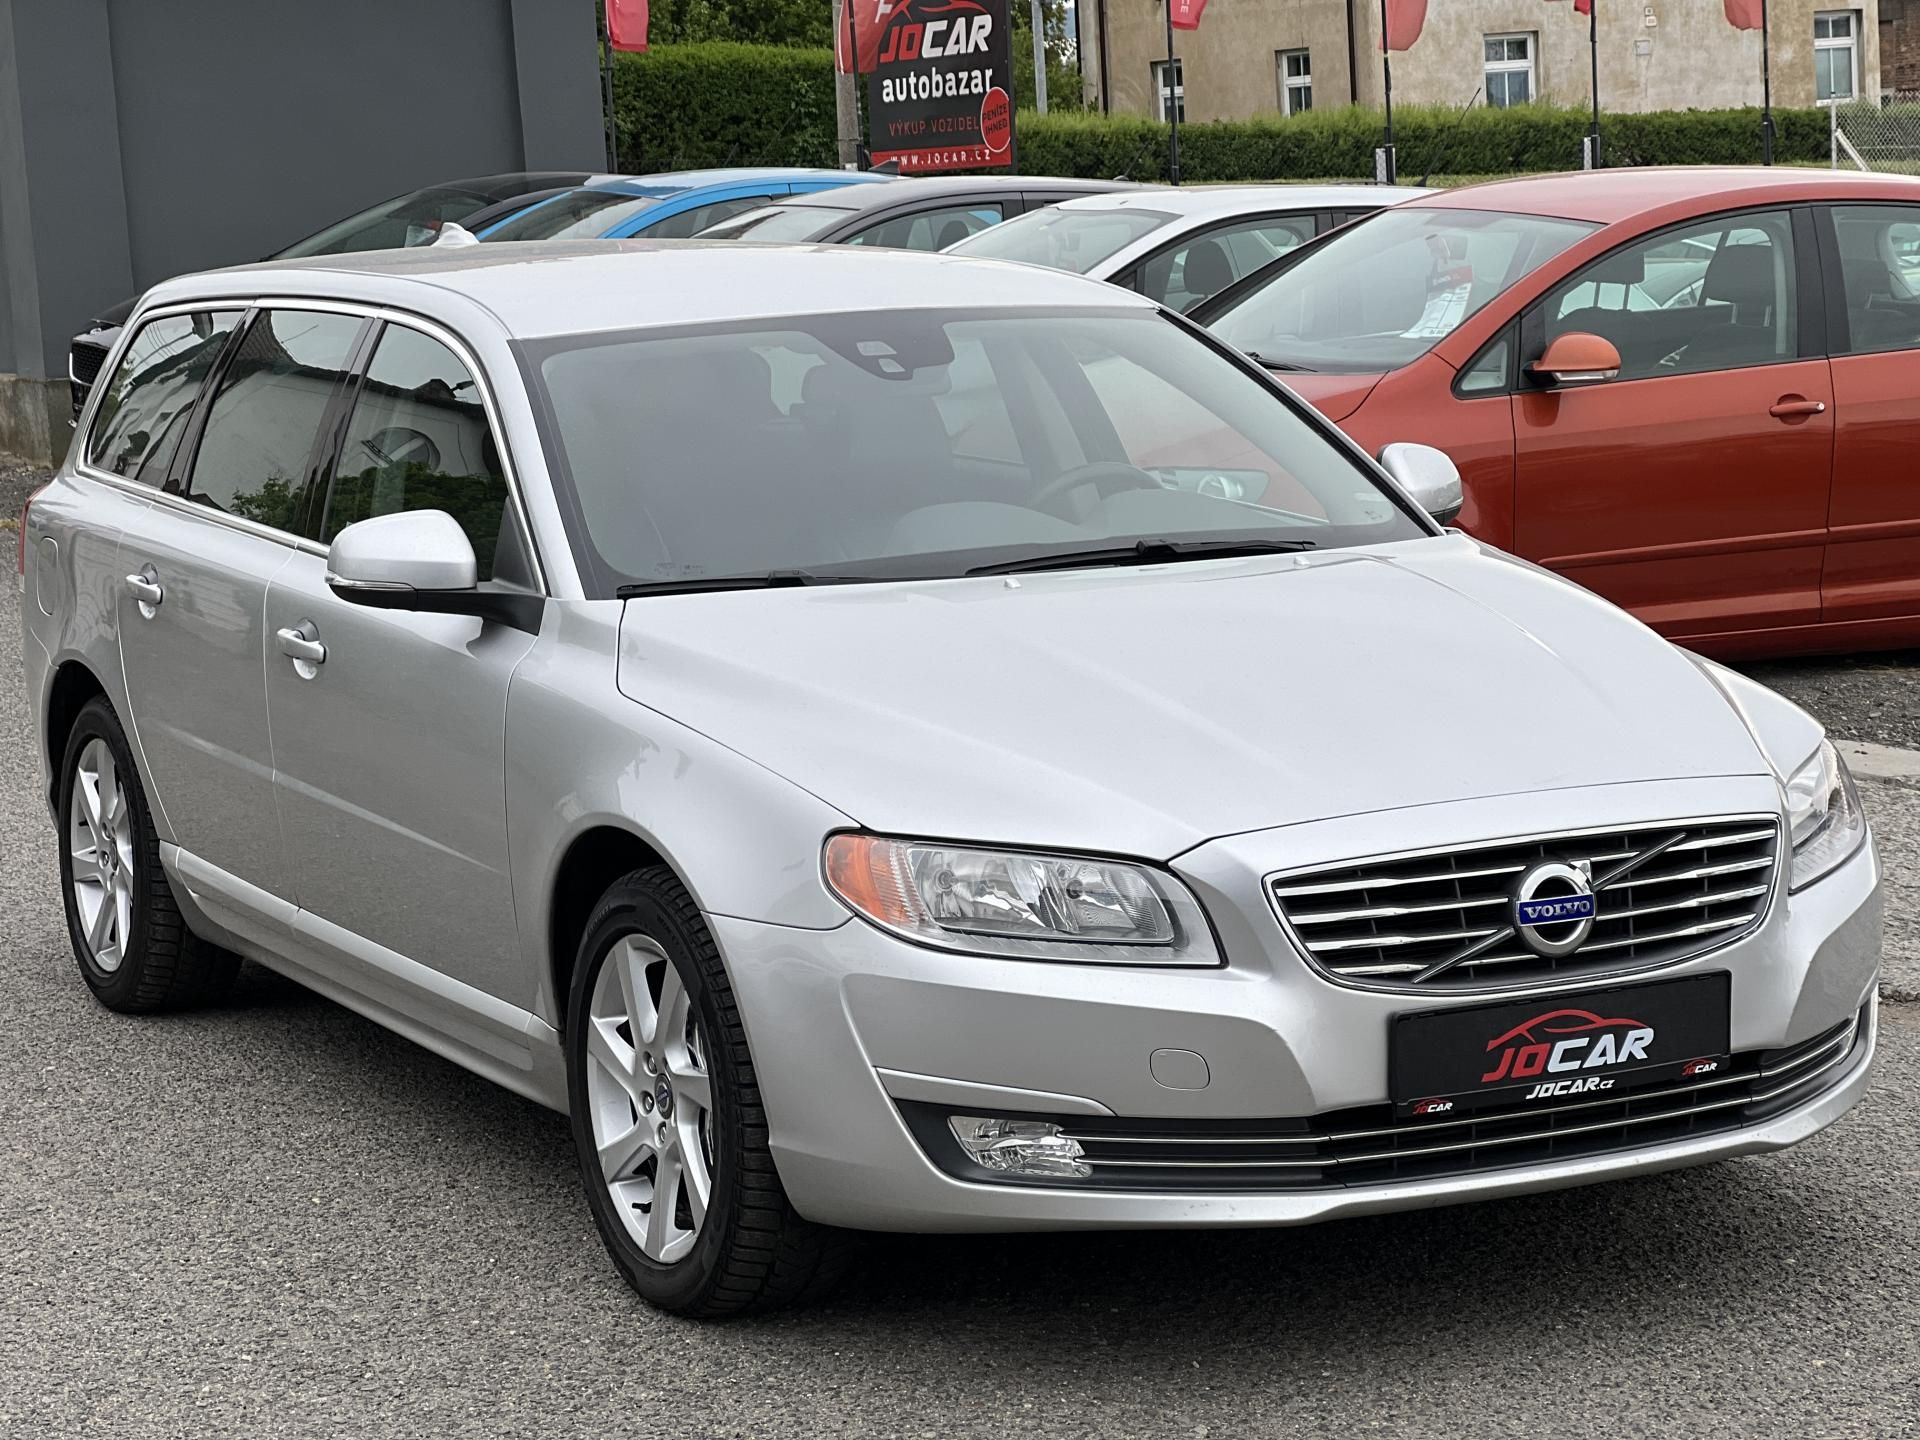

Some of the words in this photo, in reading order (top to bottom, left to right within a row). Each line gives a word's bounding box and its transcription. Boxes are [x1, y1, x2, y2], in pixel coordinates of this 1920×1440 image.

[880, 14, 993, 63] JOCAR
[882, 67, 993, 103] autobazar
[889, 119, 926, 137] VÝKUP
[930, 116, 979, 133] VOZIDEL
[985, 119, 1008, 135] IHNED
[1523, 900, 1591, 919] VOLVO
[1481, 1027, 1655, 1082] JOCAR
[1681, 1062, 1718, 1076] JOCAR
[1412, 1102, 1453, 1115] JOCAR
